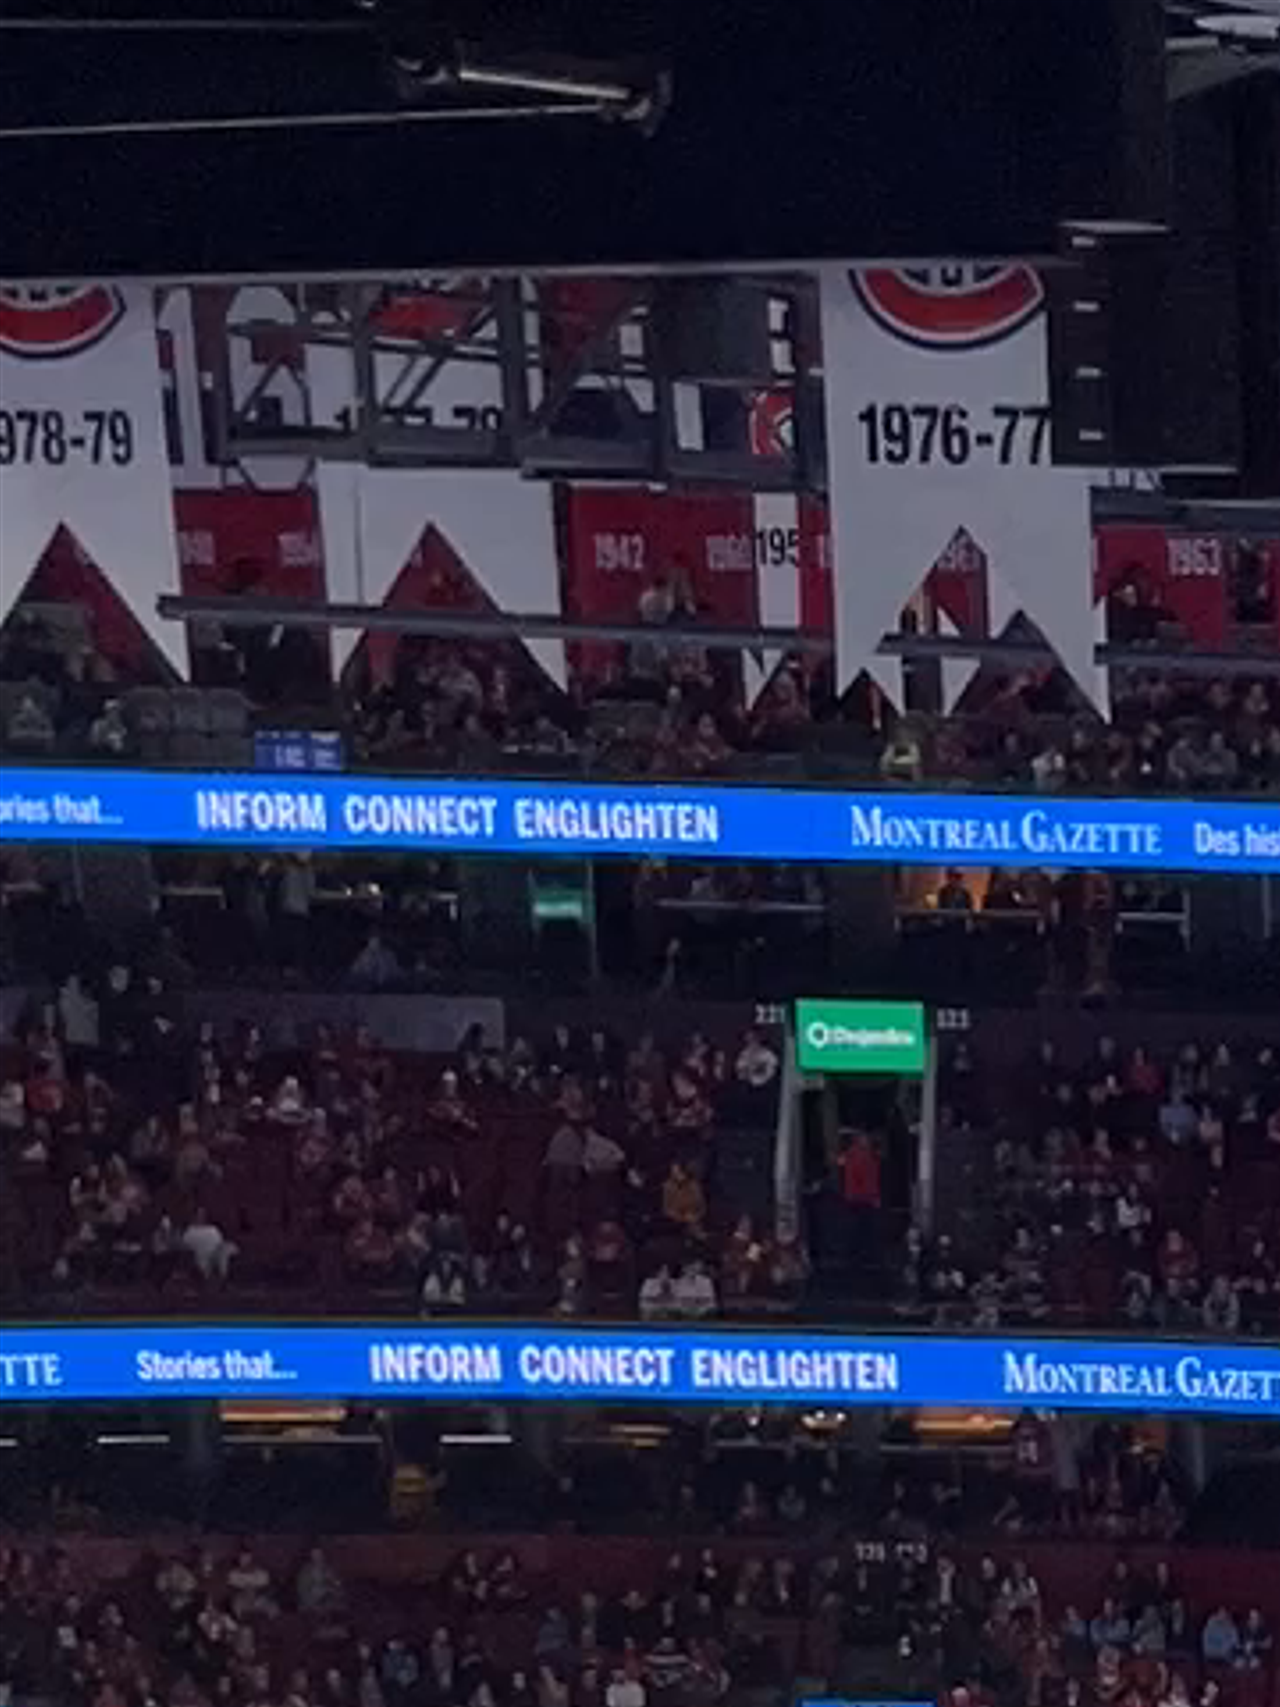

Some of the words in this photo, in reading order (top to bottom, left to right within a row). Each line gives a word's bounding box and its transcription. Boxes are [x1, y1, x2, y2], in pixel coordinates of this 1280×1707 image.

[197, 791, 325, 834] INFORM
[345, 796, 497, 839] CONNECT
[515, 798, 719, 844] ENGLIGHTEN
[851, 804, 1016, 851] MONTREAL
[1020, 808, 1163, 856] GAZETTE
[1194, 822, 1238, 857] Des
[137, 1350, 223, 1383] Stories
[370, 1344, 499, 1384] INFORM
[520, 1346, 673, 1387] CONNECT
[692, 1347, 898, 1391] ENGLIGHTEN
[1003, 1350, 1172, 1396] MONTREAL
